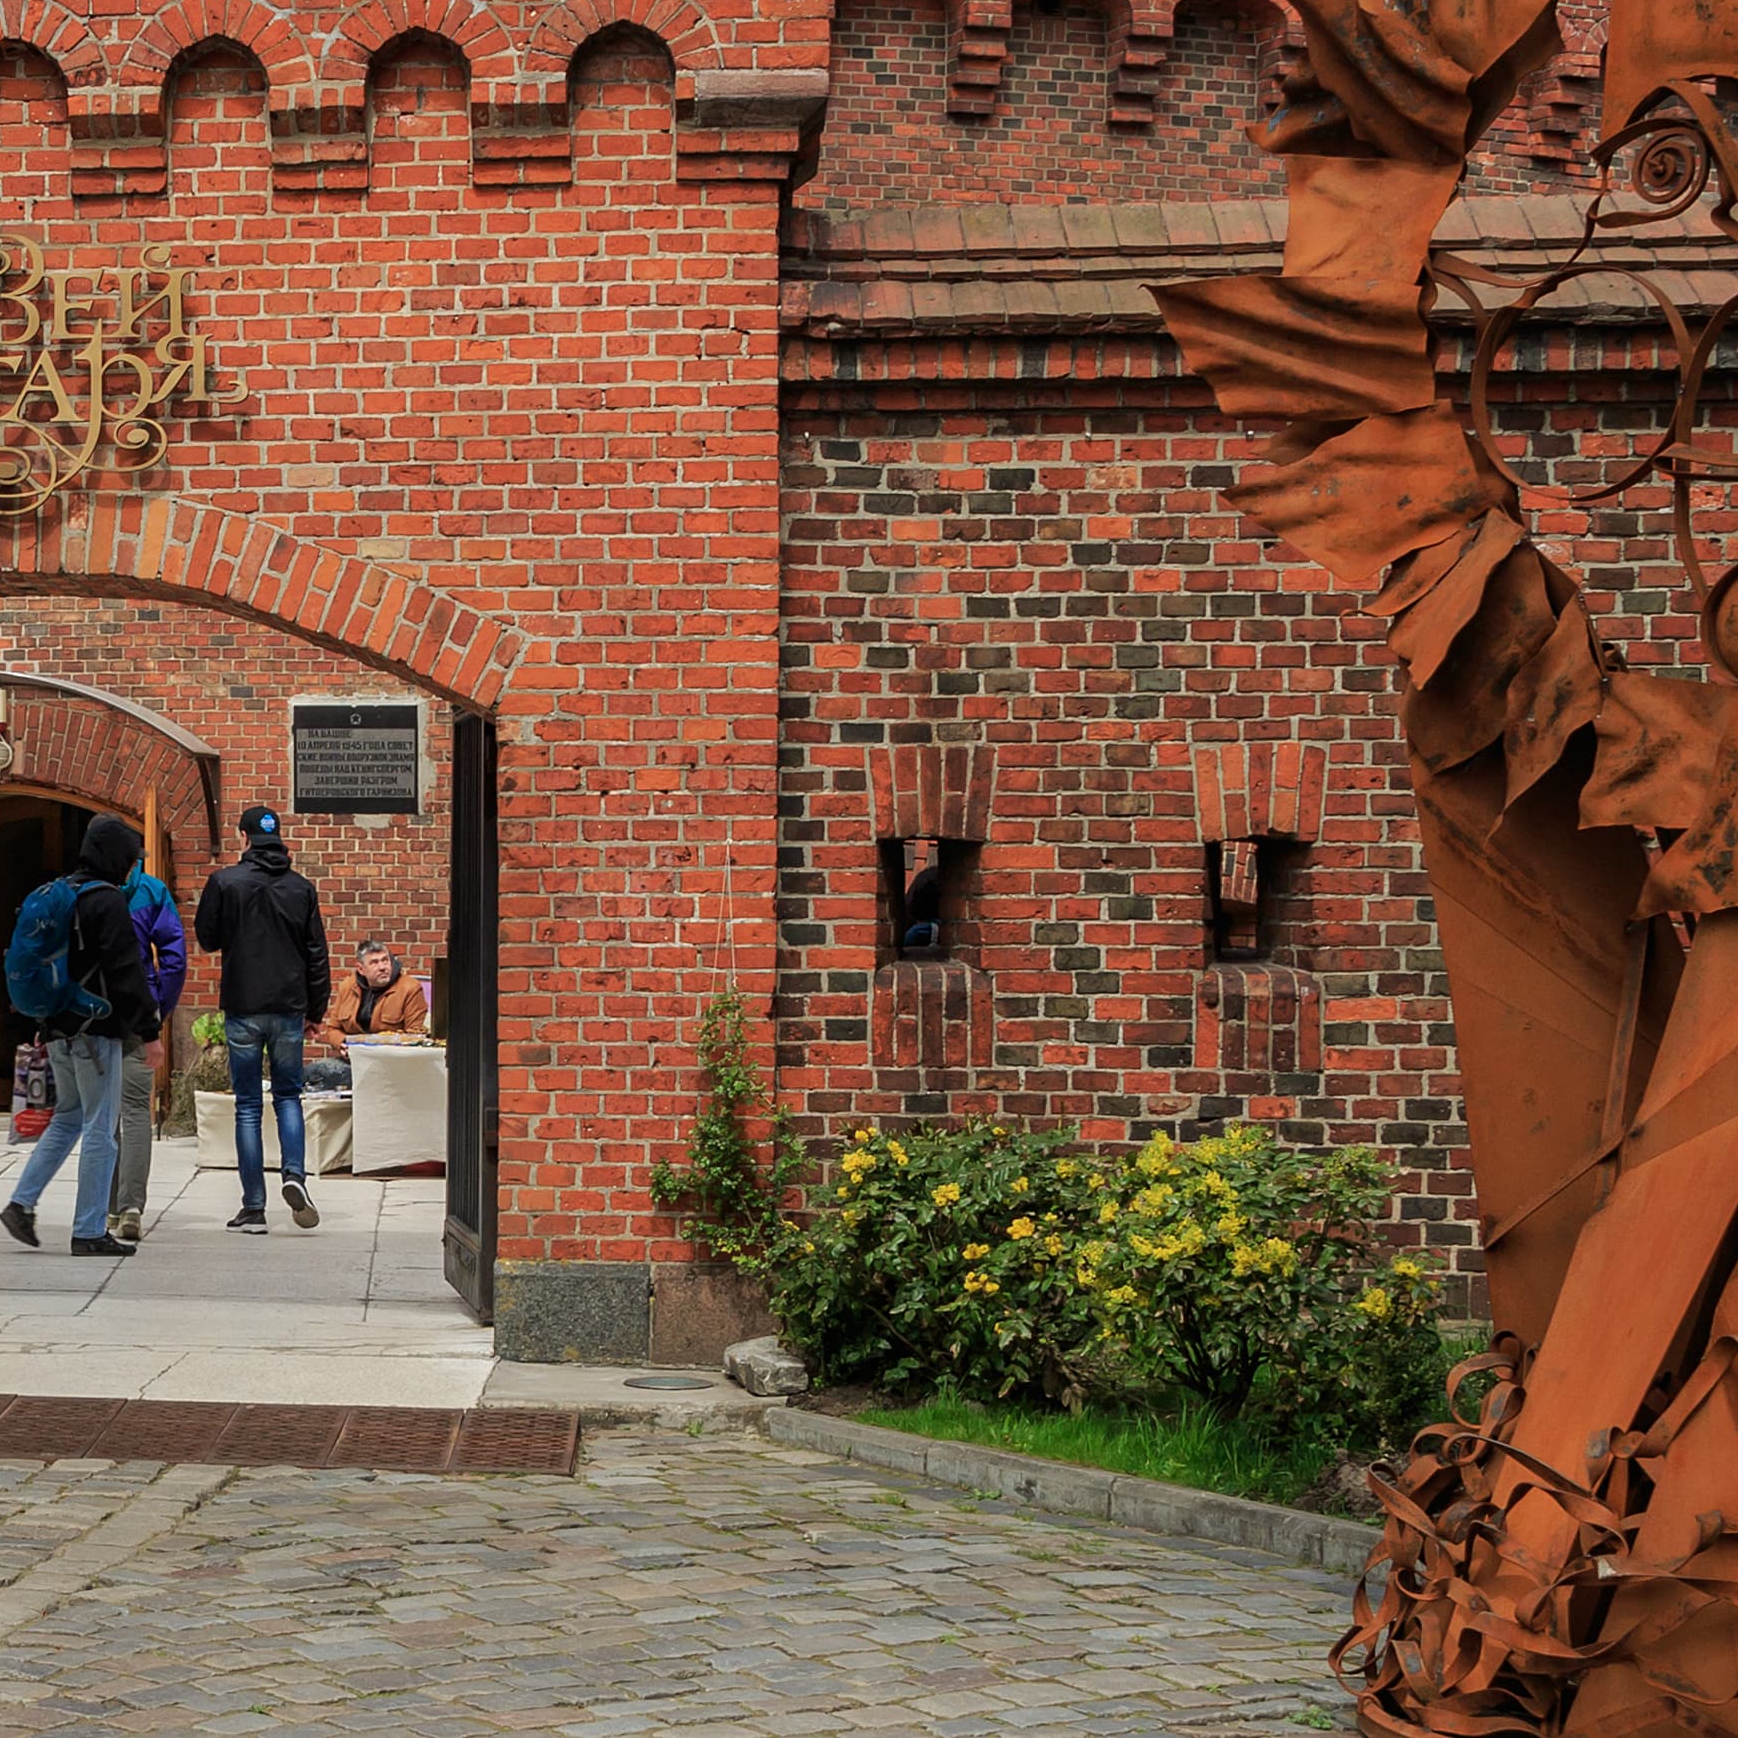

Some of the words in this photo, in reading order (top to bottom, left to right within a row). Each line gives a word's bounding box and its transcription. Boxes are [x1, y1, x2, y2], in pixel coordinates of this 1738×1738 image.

[297, 741, 306, 750] 10
[342, 741, 362, 750] 1945
[363, 741, 386, 750] ГОДА
